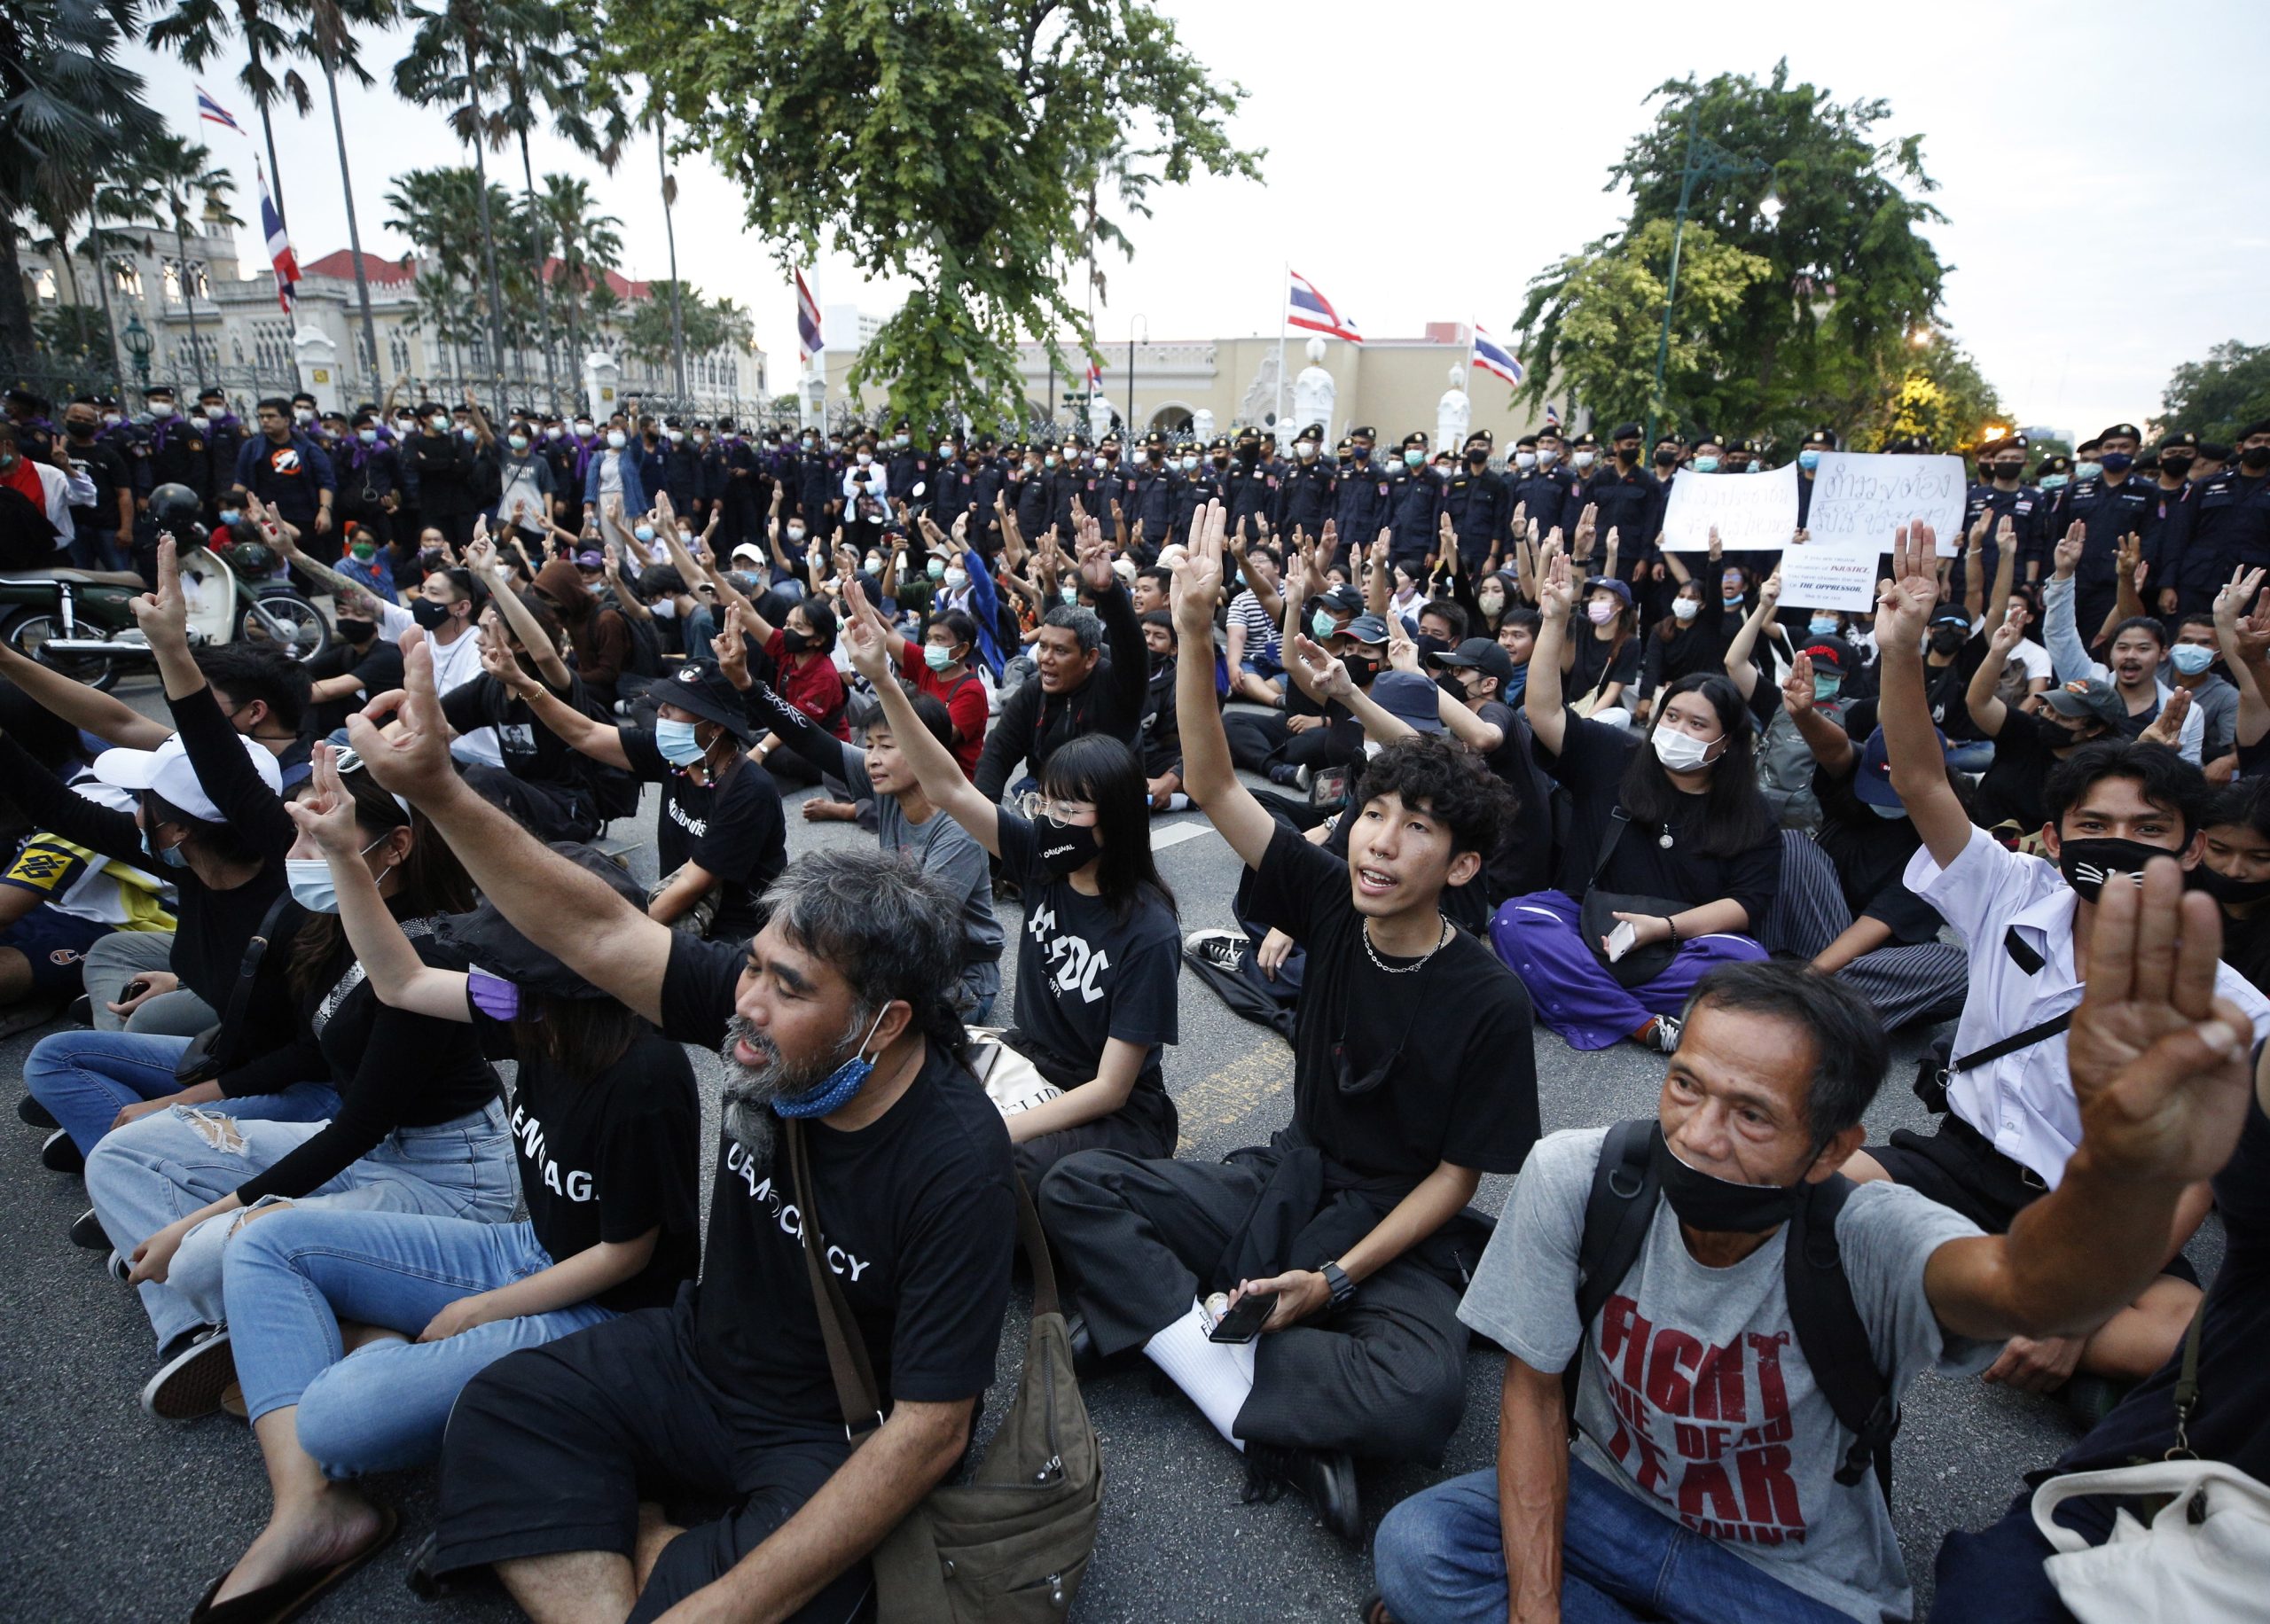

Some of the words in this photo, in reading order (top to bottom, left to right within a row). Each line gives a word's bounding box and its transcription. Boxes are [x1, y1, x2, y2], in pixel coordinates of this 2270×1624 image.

[1830, 565, 1871, 574] INJUSTICE,
[1815, 583, 1863, 593] OPPRESSOR,
[1043, 843, 1076, 858] ORIGINAL
[1047, 977, 1062, 999] 1973
[727, 1141, 871, 1283] DEMOCCY
[1601, 1293, 1790, 1423] FIGHT
[1673, 1409, 1794, 1461] DEAD
